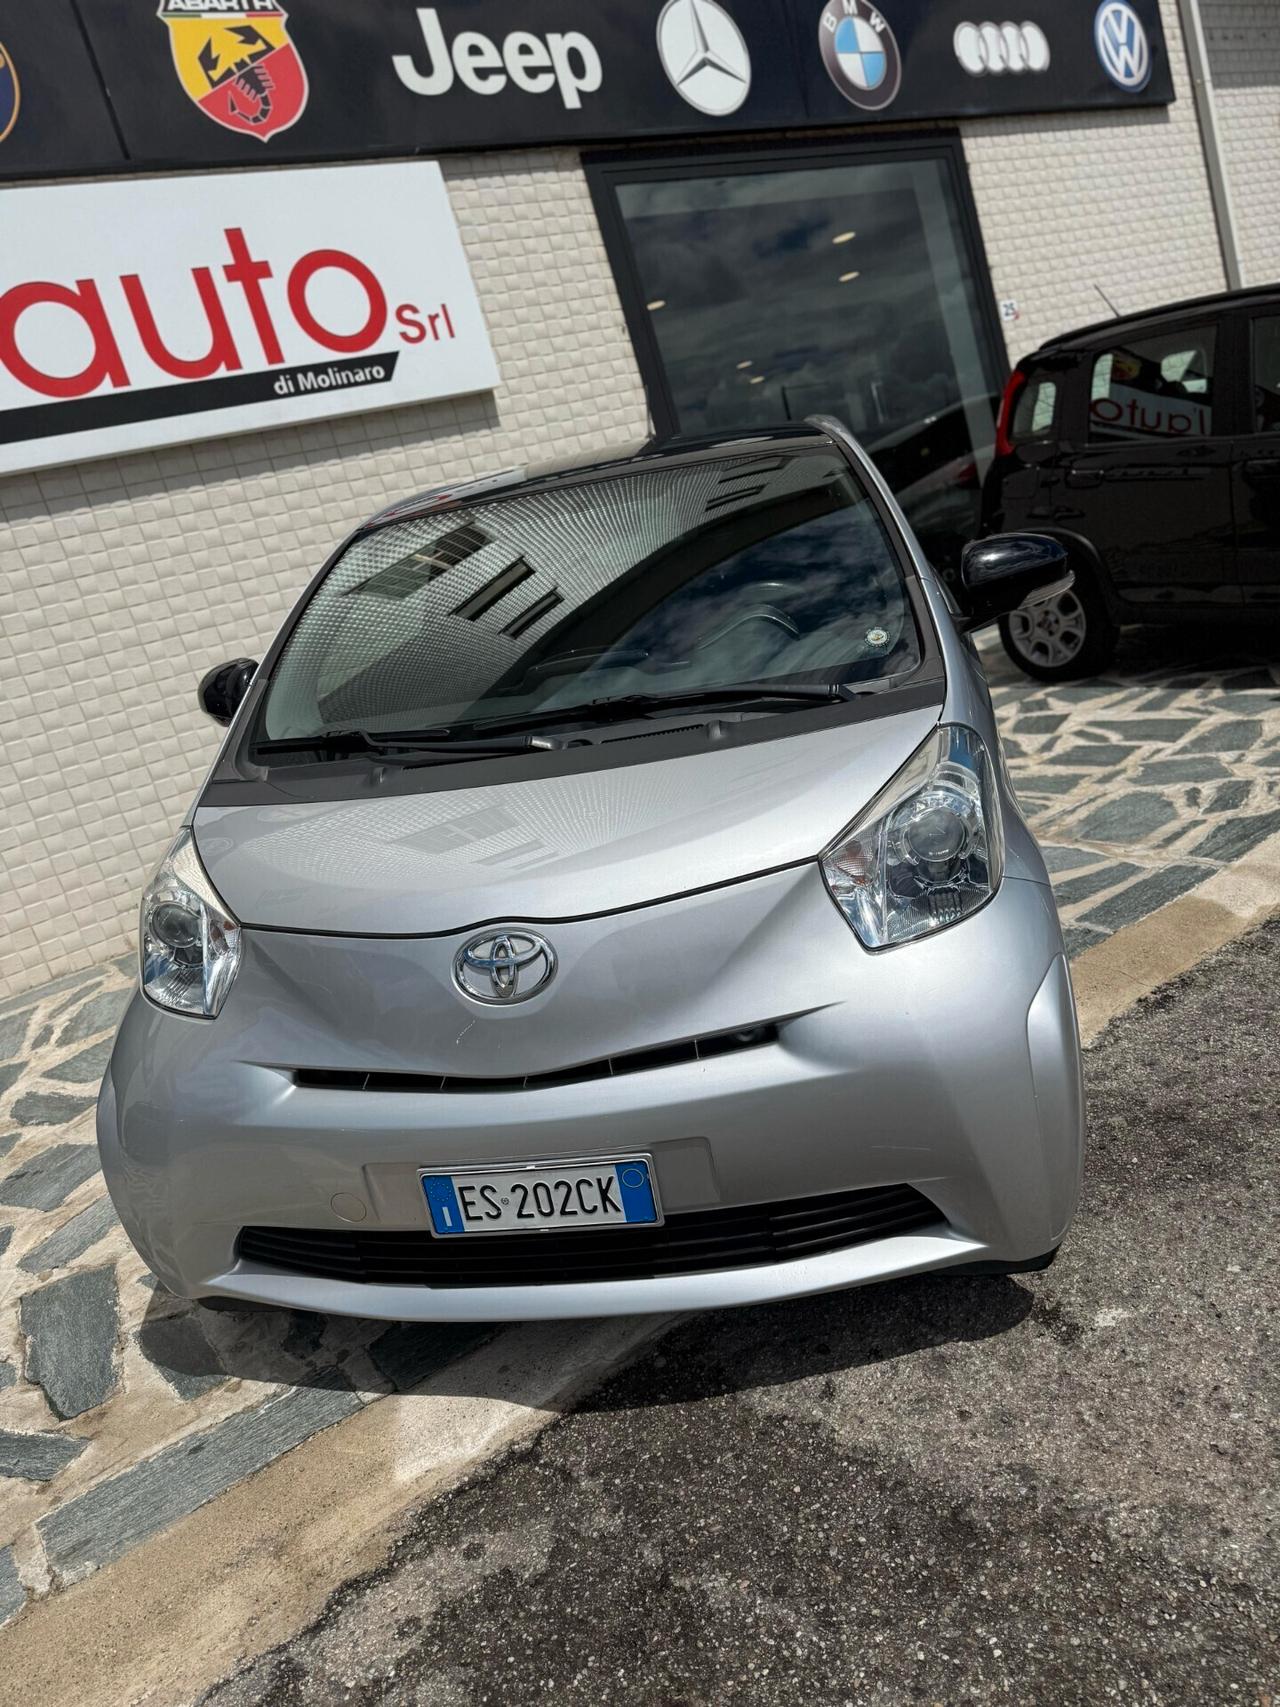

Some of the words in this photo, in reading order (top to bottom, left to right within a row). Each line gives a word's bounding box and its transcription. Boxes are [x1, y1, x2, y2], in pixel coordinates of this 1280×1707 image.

[823, 0, 886, 33] BMW
[392, 7, 603, 109] Jeep
[0, 228, 388, 398] auto
[395, 303, 455, 344] Srl
[273, 375, 294, 395] di
[297, 365, 385, 392] Molinaro
